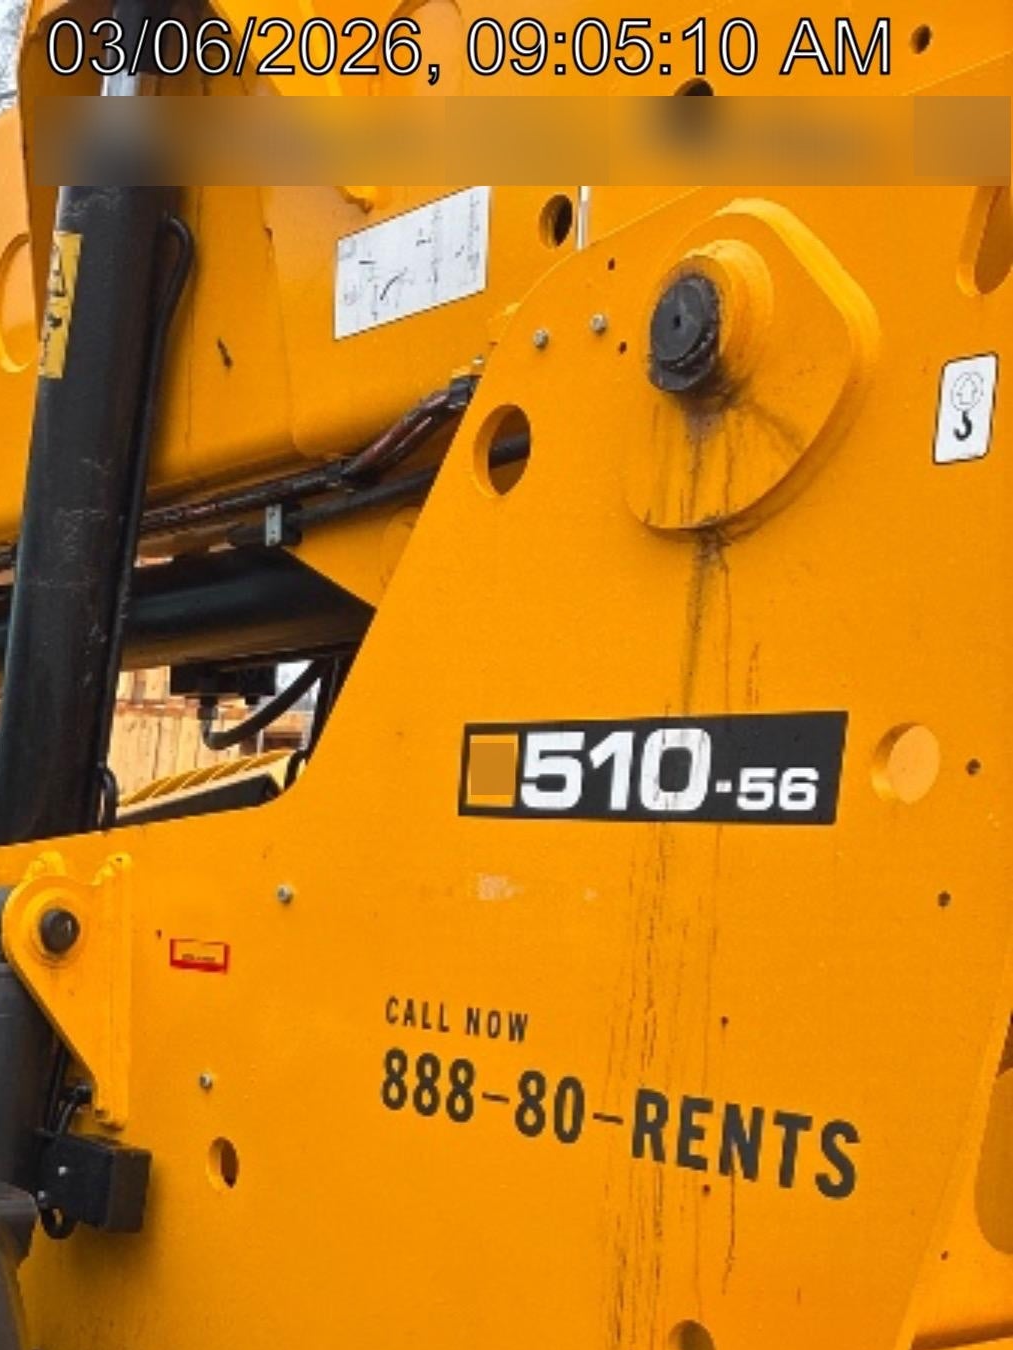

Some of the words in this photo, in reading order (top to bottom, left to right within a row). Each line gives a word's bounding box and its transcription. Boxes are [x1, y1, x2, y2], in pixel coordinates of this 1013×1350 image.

[385, 996, 450, 1034] CALL
[465, 1007, 529, 1043] NOW
[381, 1047, 861, 1200] 888-80-RENTS
